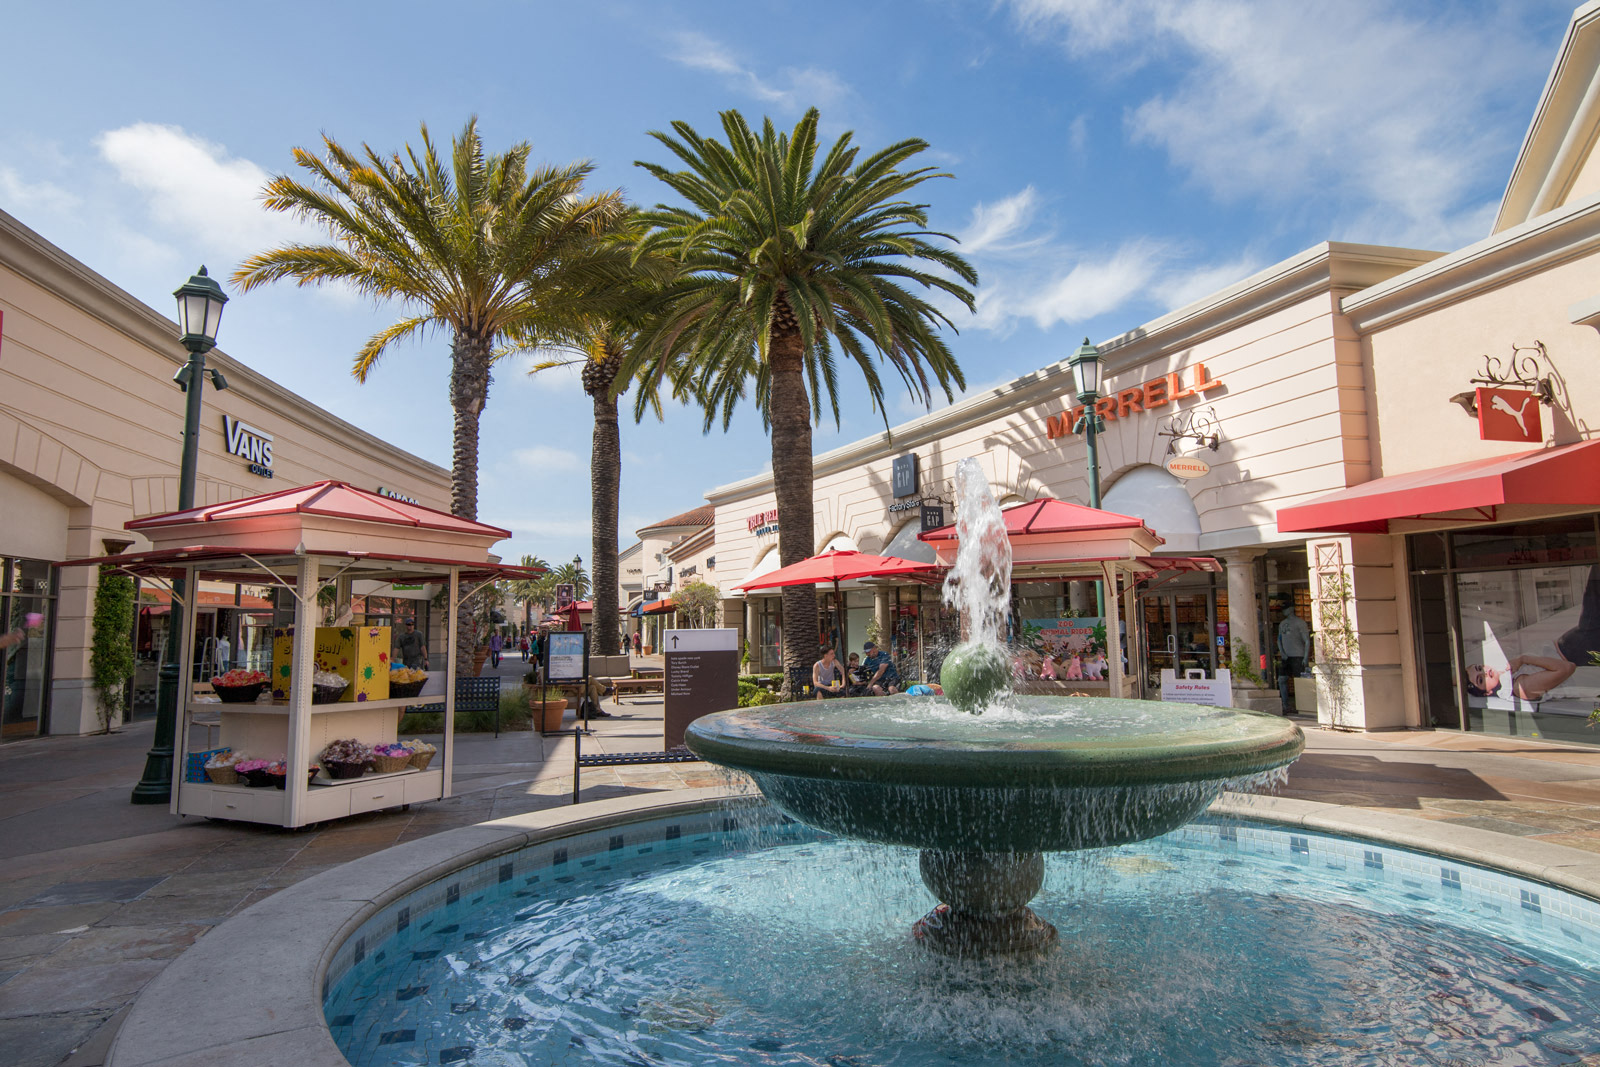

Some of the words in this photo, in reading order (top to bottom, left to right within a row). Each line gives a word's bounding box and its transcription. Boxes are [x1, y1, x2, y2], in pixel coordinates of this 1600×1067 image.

[222, 414, 274, 468] VANS
[250, 463, 274, 479] OUTLET
[1169, 463, 1209, 472] MERRELL
[897, 470, 910, 488] GAP
[889, 501, 907, 513] Factory
[906, 499, 920, 509] Store
[747, 512, 765, 531] TRUE
[926, 515, 940, 527] GAP
[1057, 620, 1075, 628] ZOO
[1040, 628, 1069, 636] ANIMAL
[1070, 627, 1094, 635] RIDES
[317, 643, 341, 656] Ball
